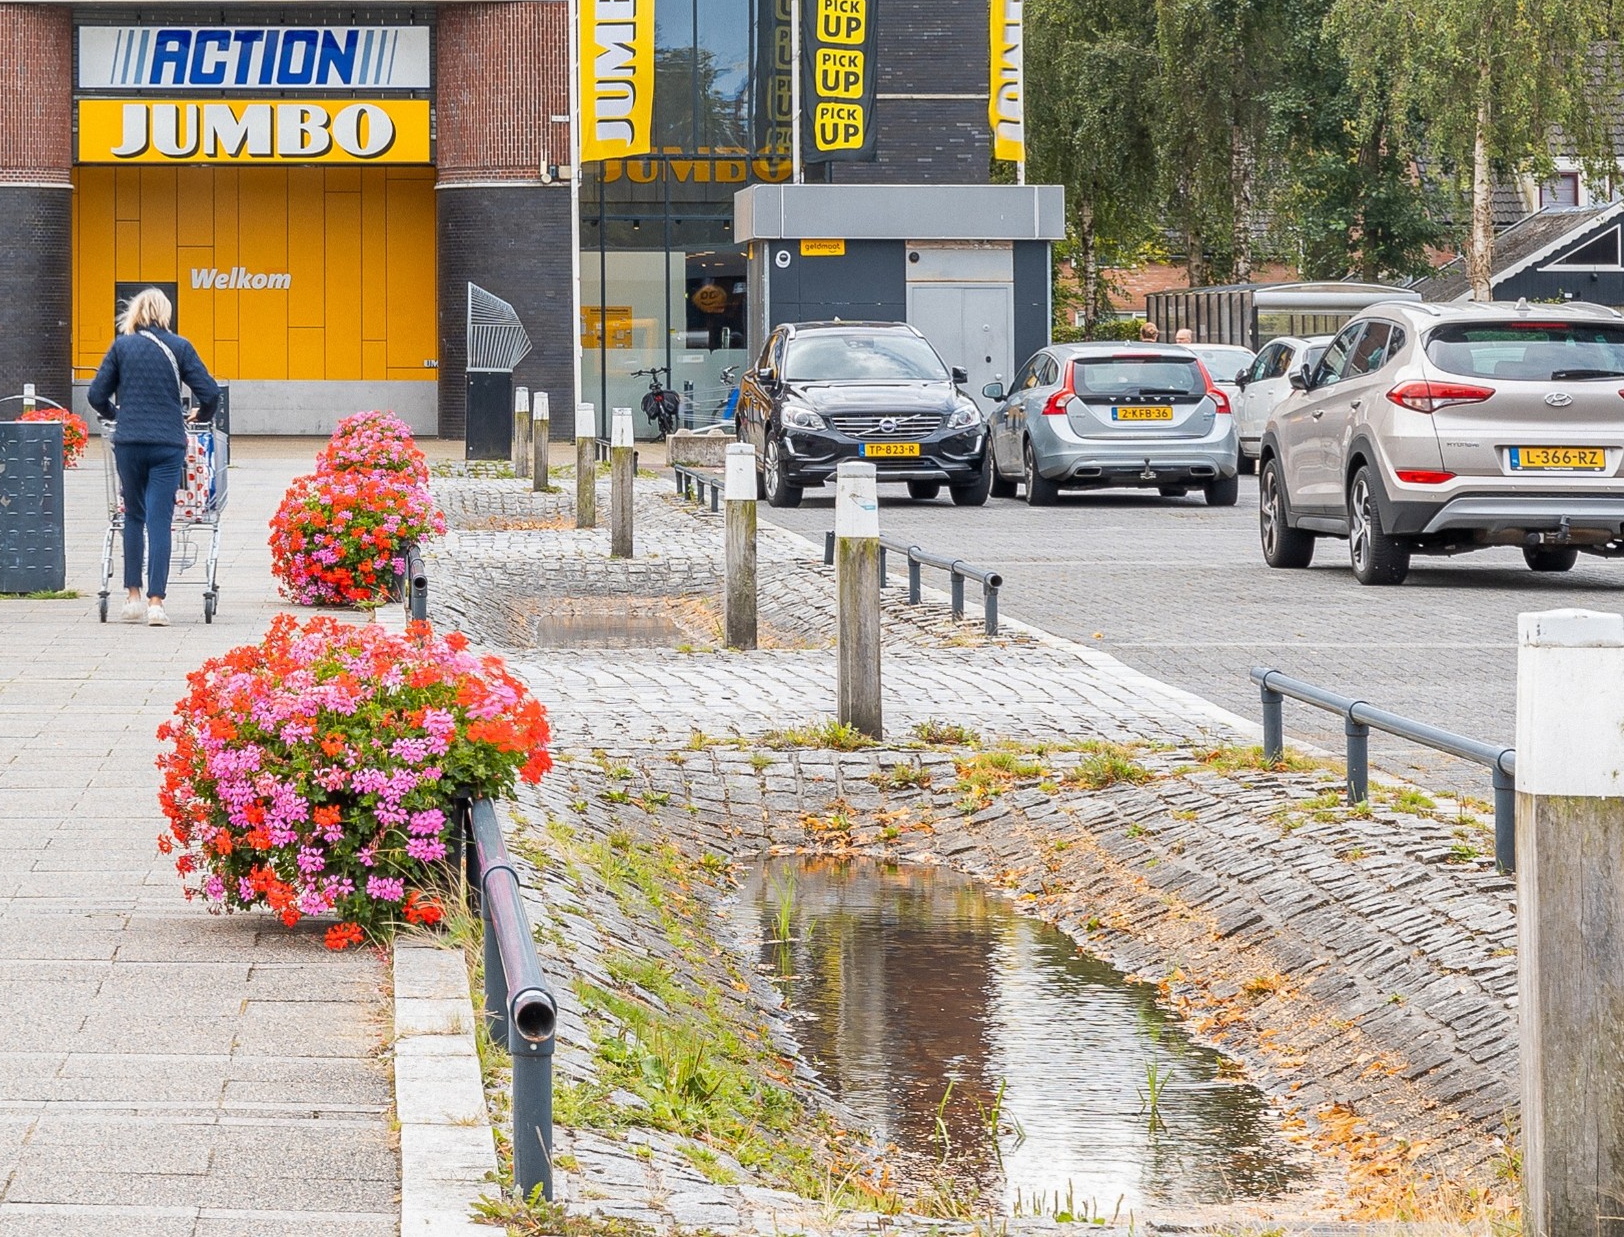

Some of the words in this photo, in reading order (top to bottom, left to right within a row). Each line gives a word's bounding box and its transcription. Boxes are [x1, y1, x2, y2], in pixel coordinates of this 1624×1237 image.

[823, 14, 862, 38] UP
[149, 29, 359, 85] ACTION
[822, 53, 858, 67] PICK
[821, 69, 860, 93] UP
[820, 107, 858, 121] PICK
[110, 103, 396, 158] JUMBO
[820, 122, 860, 145] UP
[191, 266, 292, 290] Welkom
[869, 445, 915, 455] TP-823-R
[1526, 451, 1598, 465] L-366-RZ
